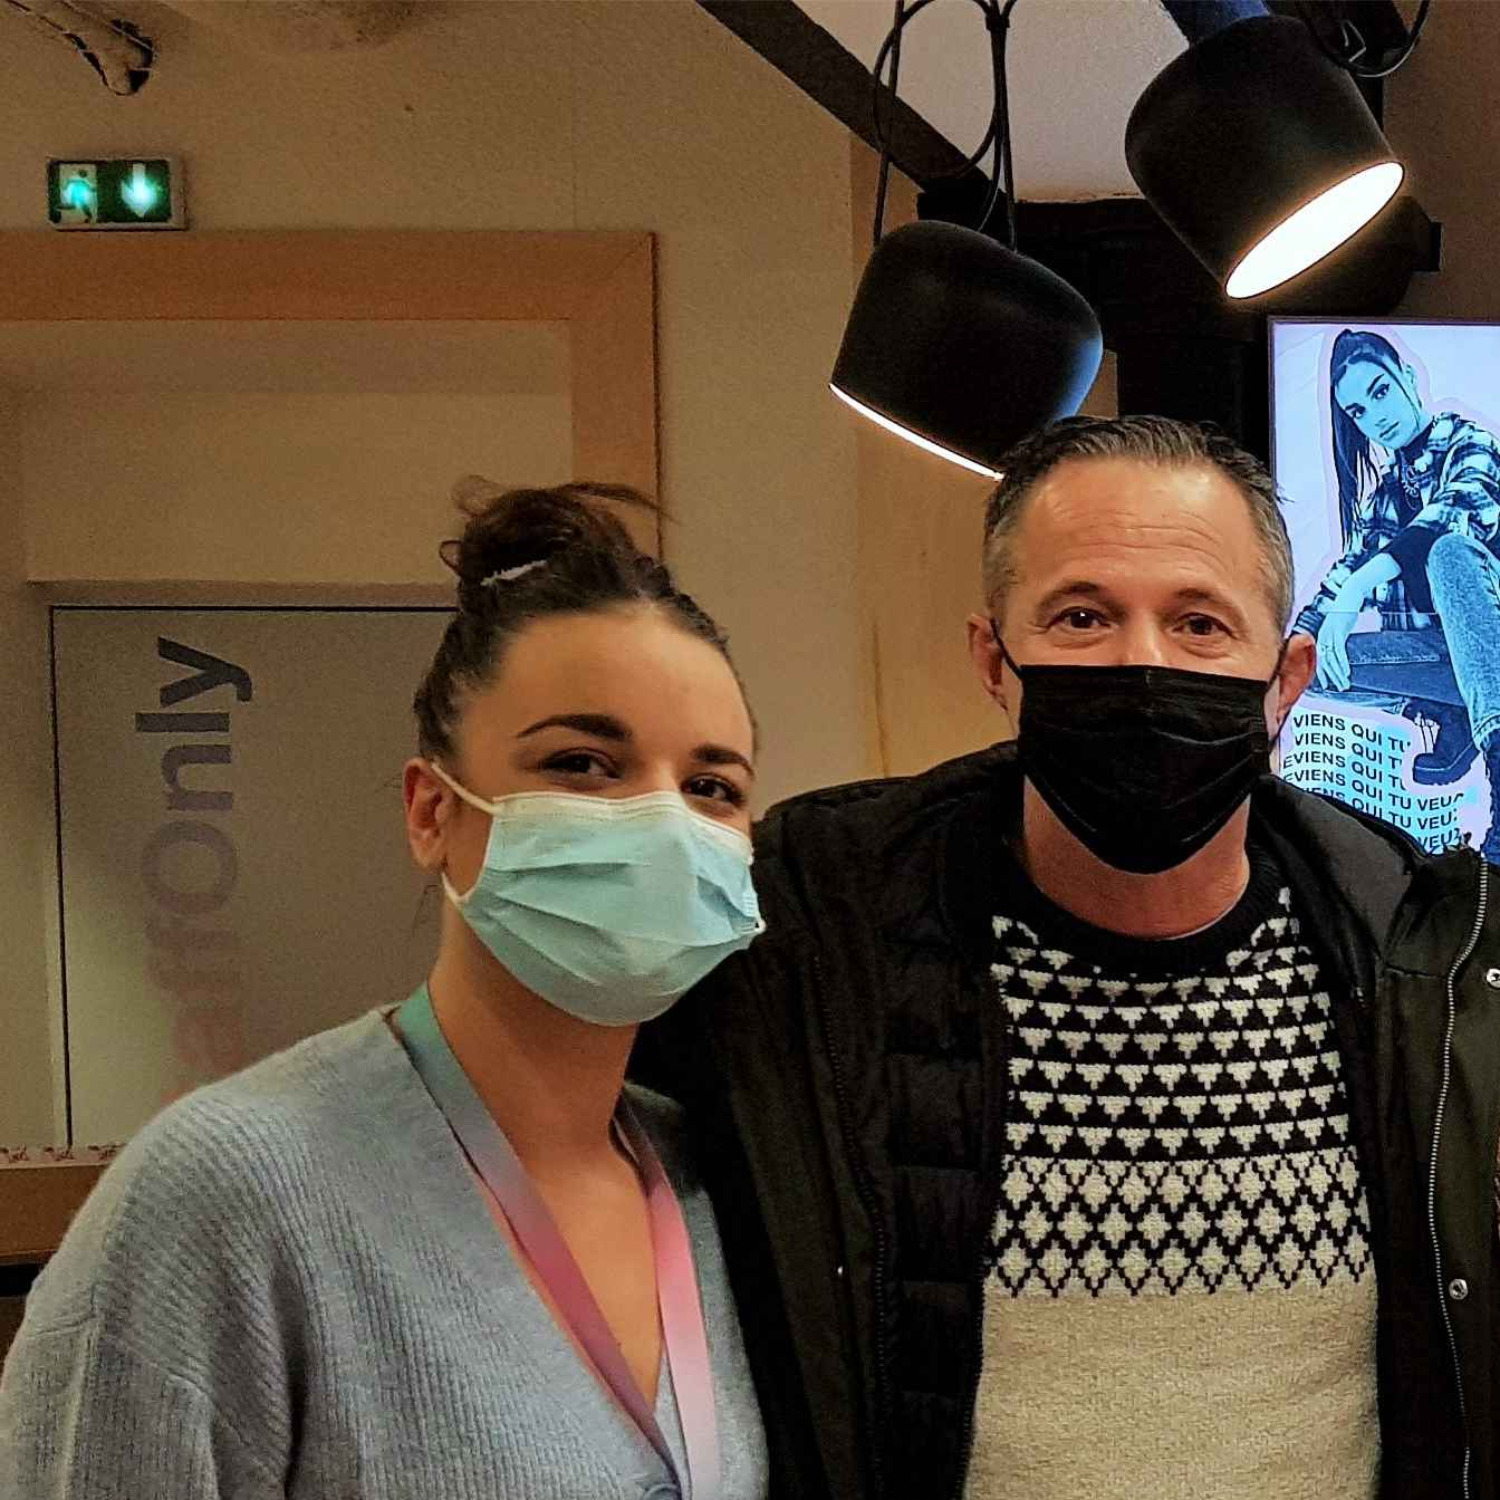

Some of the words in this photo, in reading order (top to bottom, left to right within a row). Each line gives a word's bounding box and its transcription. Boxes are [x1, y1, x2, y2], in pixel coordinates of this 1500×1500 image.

[1293, 713, 1346, 731] VIENS
[1351, 723, 1382, 746] QUI
[1295, 732, 1346, 750] VIENS
[1351, 742, 1382, 765] QUI
[1351, 761, 1382, 783] QUI
[1351, 779, 1382, 801] QUI
[1388, 792, 1412, 810] TU
[1388, 811, 1412, 828] TU
